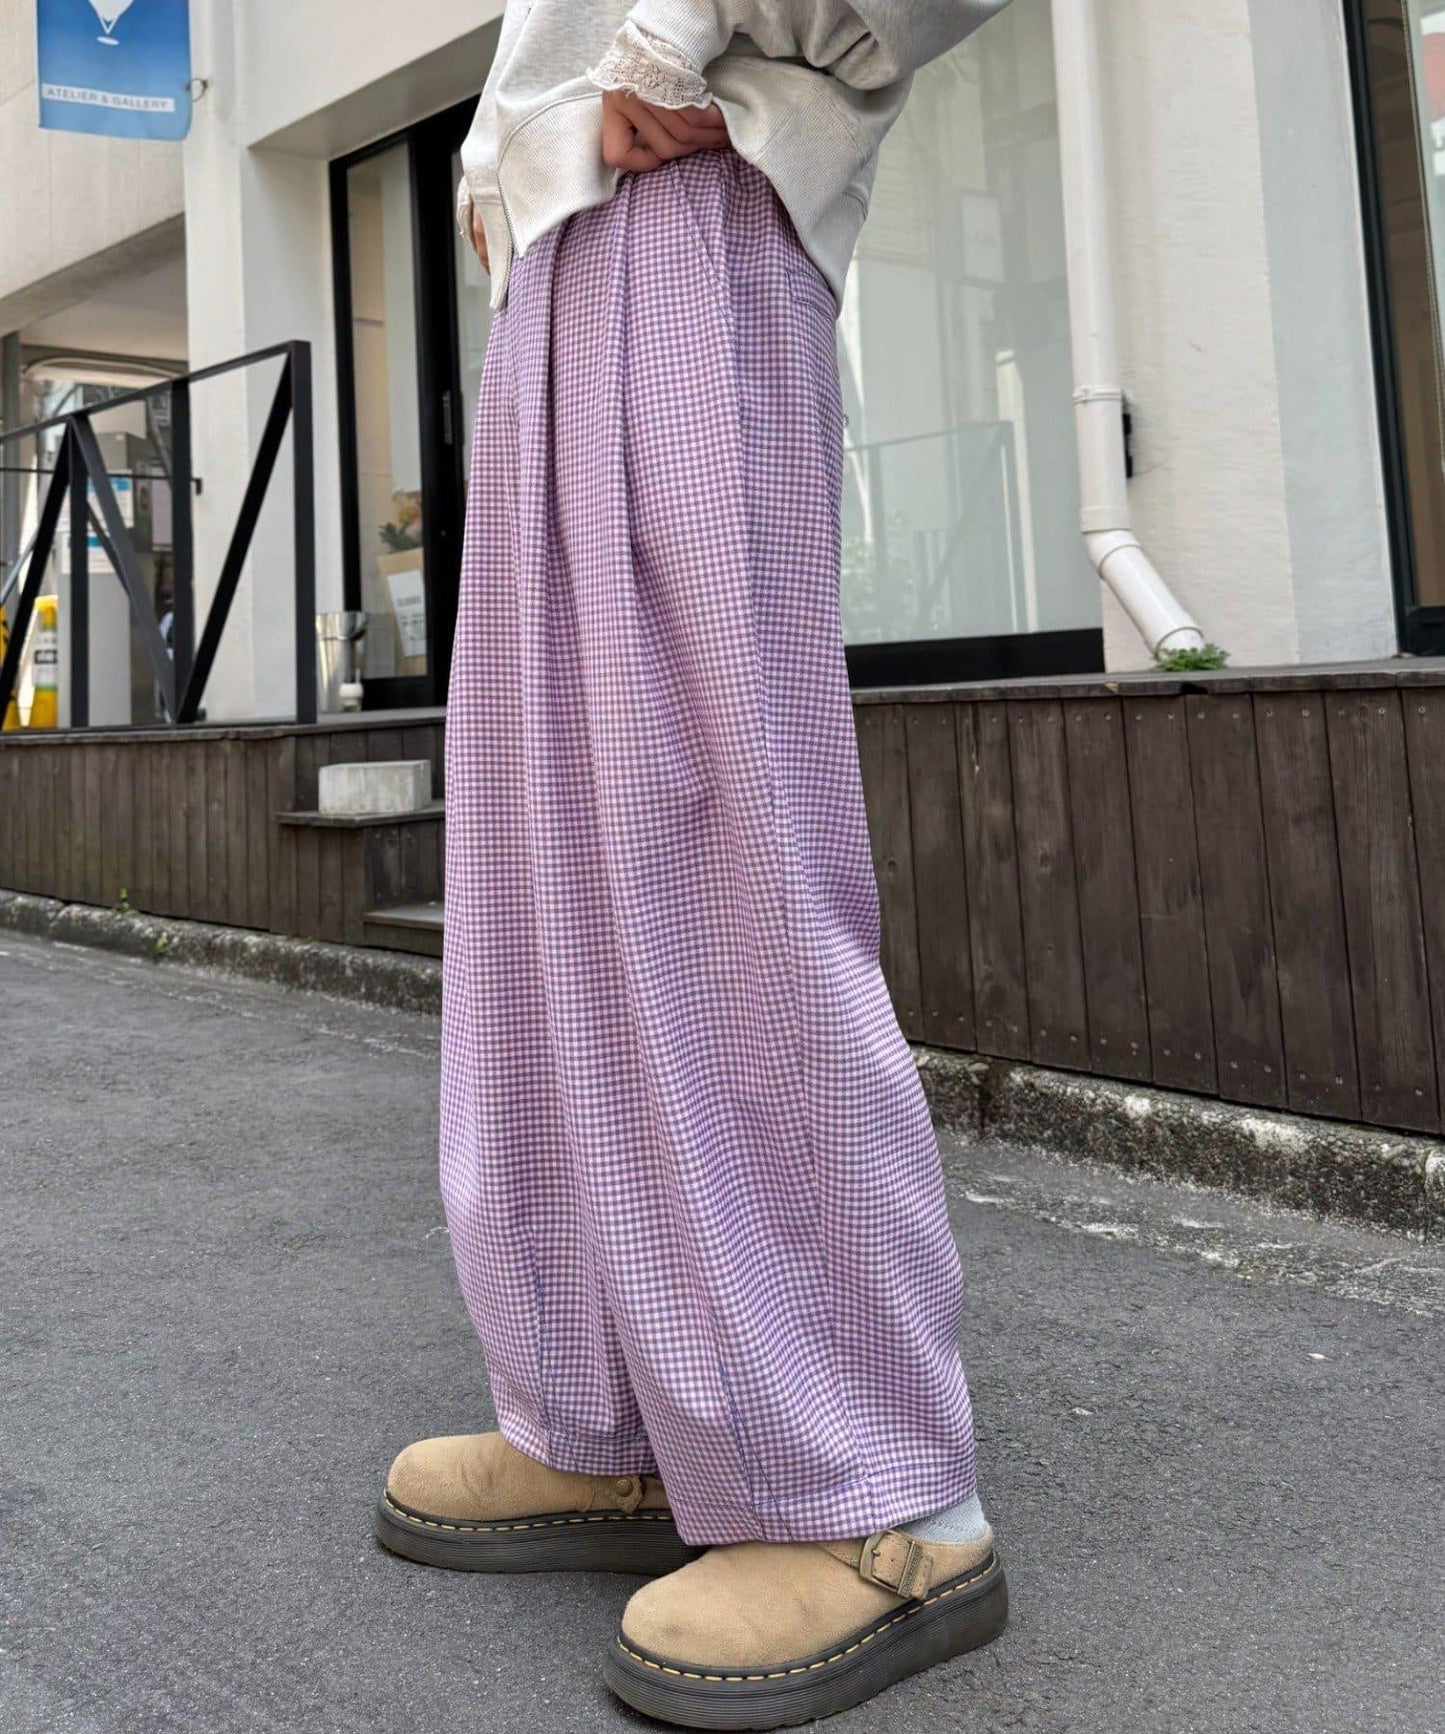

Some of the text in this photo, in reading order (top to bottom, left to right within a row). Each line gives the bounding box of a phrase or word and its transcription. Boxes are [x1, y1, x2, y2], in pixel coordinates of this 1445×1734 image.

[47, 87, 168, 109] ATELIER & GALLERY
